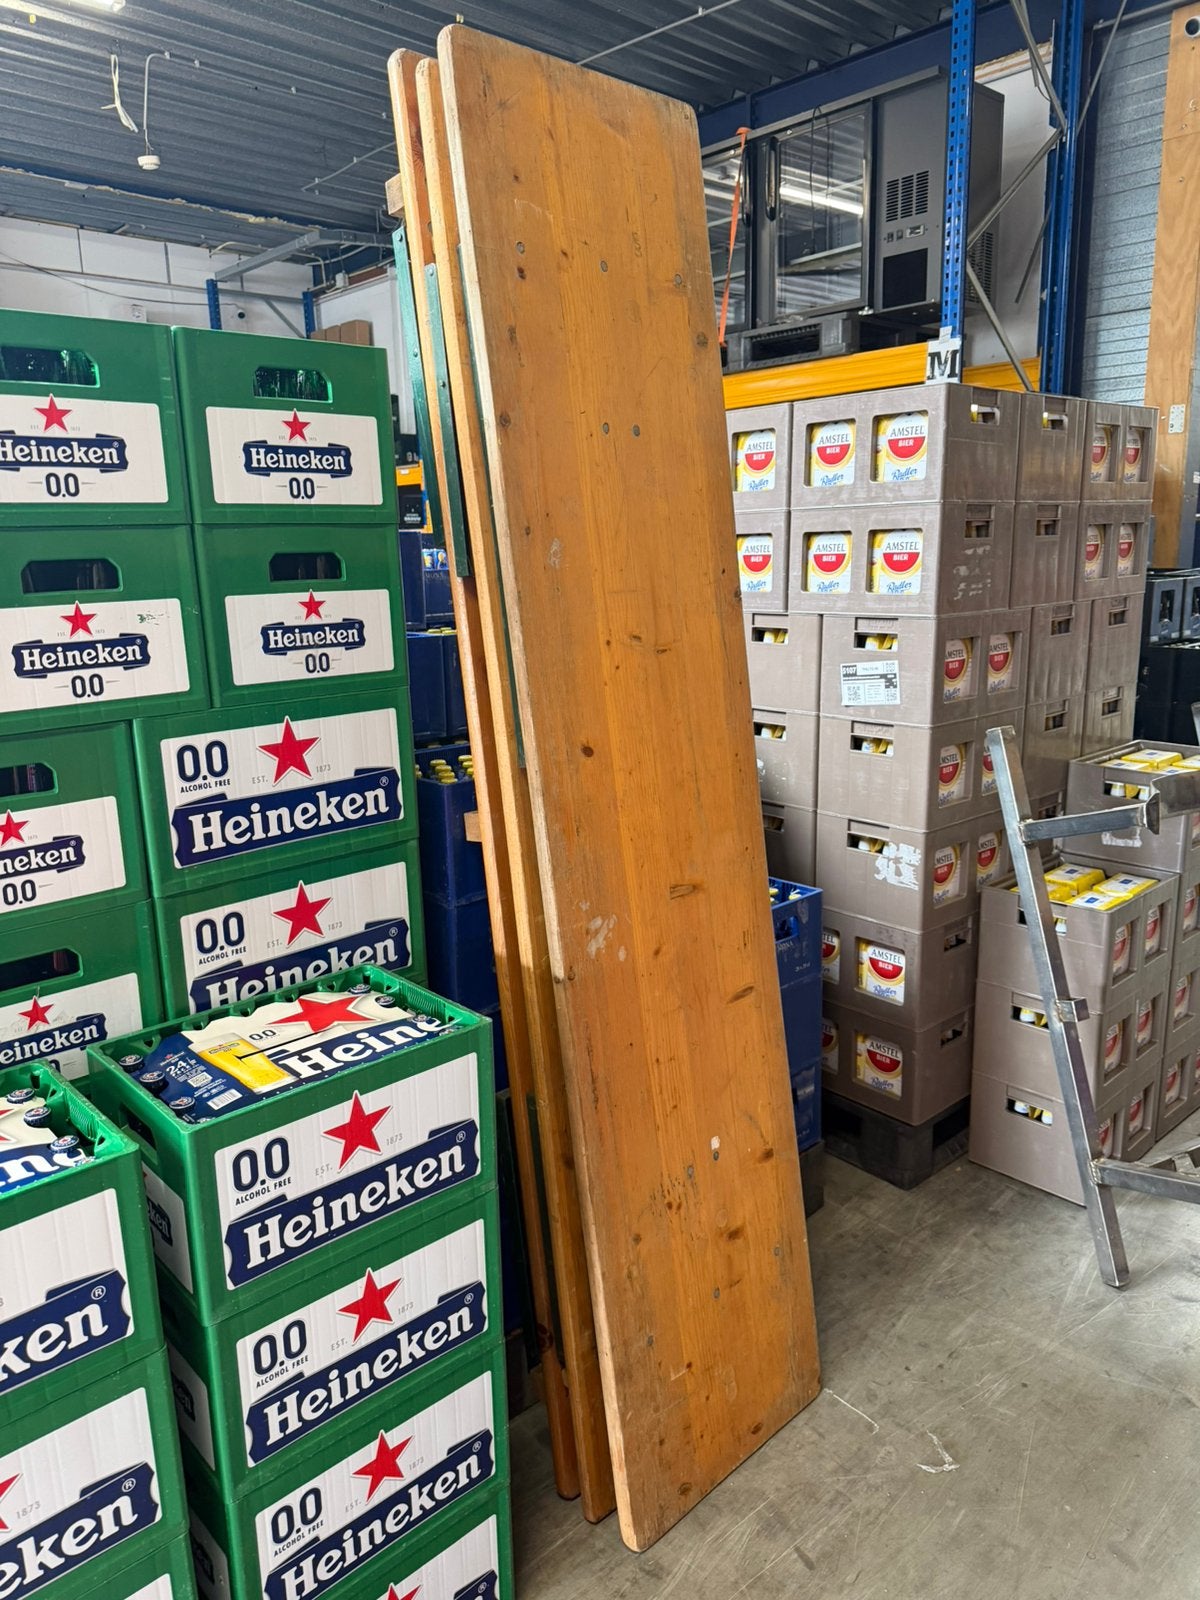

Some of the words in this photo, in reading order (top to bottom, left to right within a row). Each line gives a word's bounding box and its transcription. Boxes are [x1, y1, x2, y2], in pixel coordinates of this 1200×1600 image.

[927, 349, 960, 380] M
[818, 433, 849, 445] AMSTEL
[889, 425, 925, 437] AMSTEL
[747, 441, 773, 452] AMSTEL
[898, 439, 914, 447] BIER
[249, 448, 347, 471] Heineken
[45, 472, 80, 498] 0.0
[288, 477, 316, 500] 0.0
[744, 545, 771, 554] AMSTEL
[815, 543, 846, 552] AMSTEL
[885, 541, 920, 551] AMSTEL
[893, 553, 909, 561] BIER
[267, 626, 360, 649] Heineken
[21, 643, 143, 672] Heineken
[305, 652, 330, 674] 0.0
[71, 673, 104, 698] 0.0
[176, 740, 229, 783] 0.0
[251, 777, 268, 785] EST.
[316, 763, 331, 773] 1873
[180, 781, 212, 794] ALCOHOL
[214, 778, 231, 788] FREE
[188, 787, 390, 854] Heineken
[2, 879, 37, 906] 0.0
[195, 911, 246, 955] 0.0
[266, 939, 283, 949] EST.
[328, 921, 343, 931] 1873
[198, 951, 229, 965] ALCOHOL
[231, 945, 247, 955] FREE
[871, 949, 901, 964] AMSTEL
[878, 961, 893, 971] BIER
[869, 1041, 900, 1058] AMSTEL
[876, 1053, 891, 1065] BIER
[232, 1137, 290, 1192] 0.0
[315, 1165, 333, 1176] EST.
[386, 1133, 403, 1146] 1873
[235, 1186, 271, 1206] ALCOHOL
[274, 1177, 292, 1190] FREE
[243, 1144, 466, 1269] Heineken
[330, 1339, 348, 1352] EST.
[397, 1301, 414, 1315] 1873
[253, 1319, 307, 1375] 0.0
[256, 1366, 289, 1388] ALCOHOL
[291, 1355, 309, 1369] FREE
[263, 1307, 474, 1446] Heineken
[409, 1456, 425, 1470] 1873
[16, 1500, 41, 1520] 1873
[271, 1487, 323, 1545] 0.0
[281, 1453, 482, 1600] Heineken
[273, 1533, 306, 1558] ALCOHOL
[308, 1520, 324, 1535] FREE
